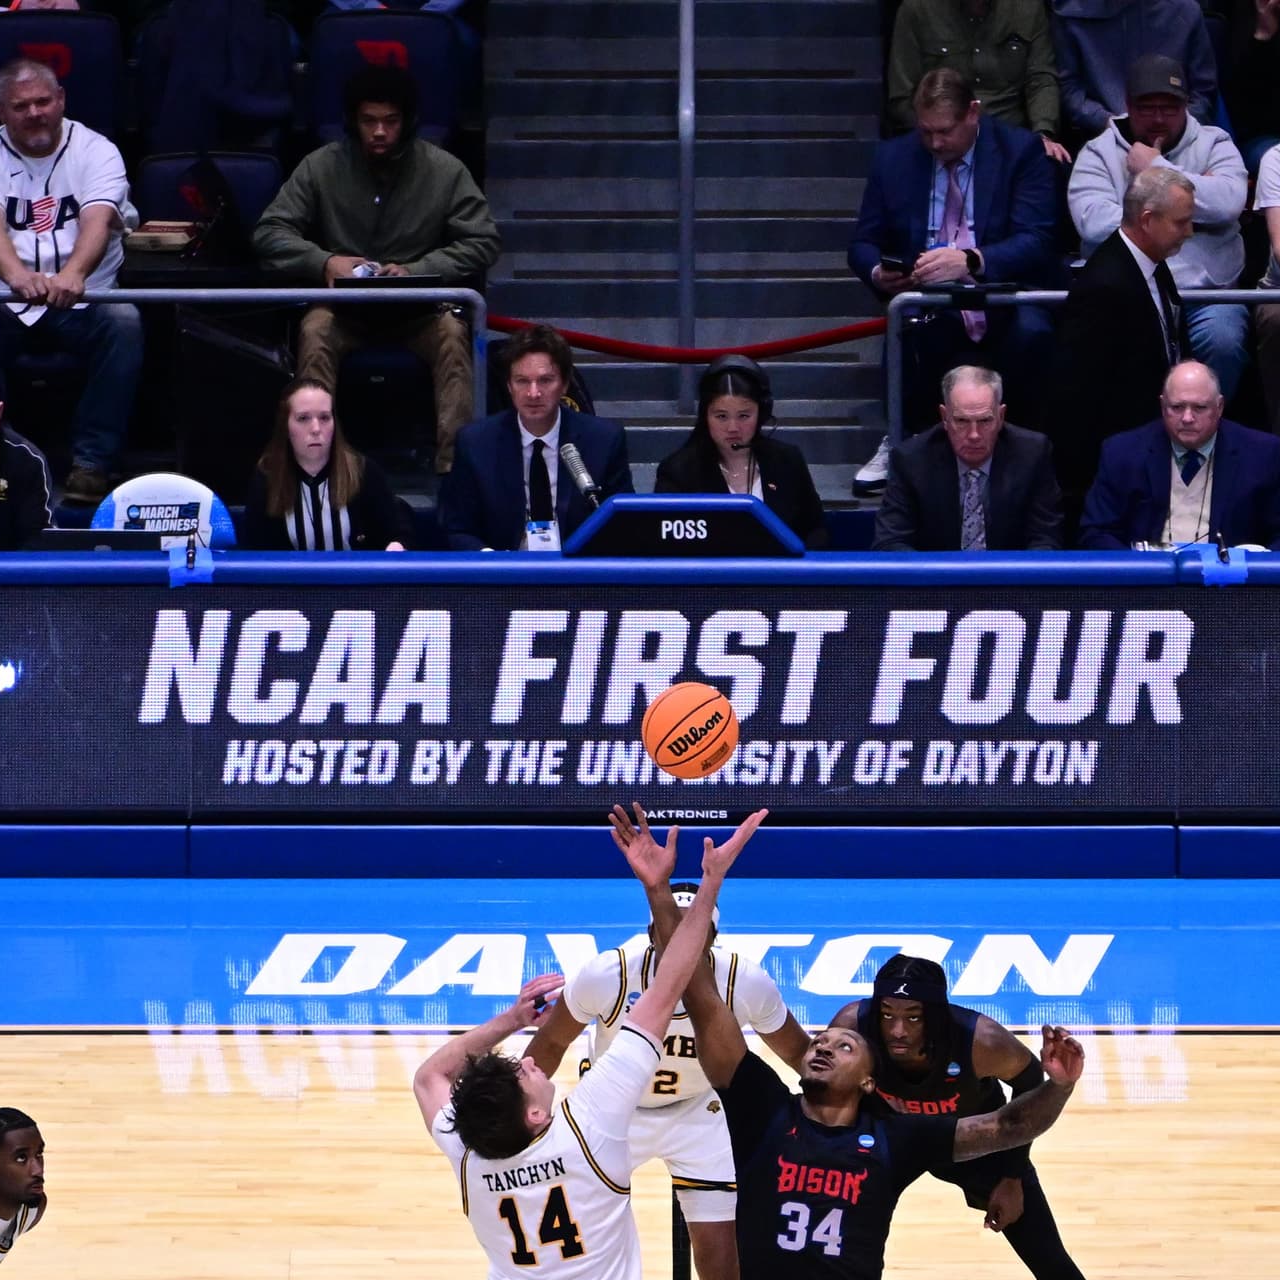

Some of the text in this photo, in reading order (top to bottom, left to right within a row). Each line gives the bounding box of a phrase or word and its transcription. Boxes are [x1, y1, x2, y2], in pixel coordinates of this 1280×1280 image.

[6, 194, 80, 233] USA
[139, 506, 179, 519] MARCH
[144, 518, 198, 531] MADNESS
[662, 519, 707, 540] POSS
[138, 610, 1194, 724] NCAA FIRST FOUR
[667, 710, 723, 757] Wilson
[222, 740, 399, 785] HOSTED
[410, 740, 471, 785] BY
[485, 740, 566, 785] THE
[576, 740, 848, 785] UNISITY
[853, 740, 910, 785] OF
[922, 740, 1101, 785] DAYTON
[652, 1070, 679, 1095] 2
[482, 1157, 566, 1193] TANCHYN
[777, 1155, 869, 1206] BISON
[498, 1184, 586, 1267] 14
[776, 1201, 844, 1257] 34
